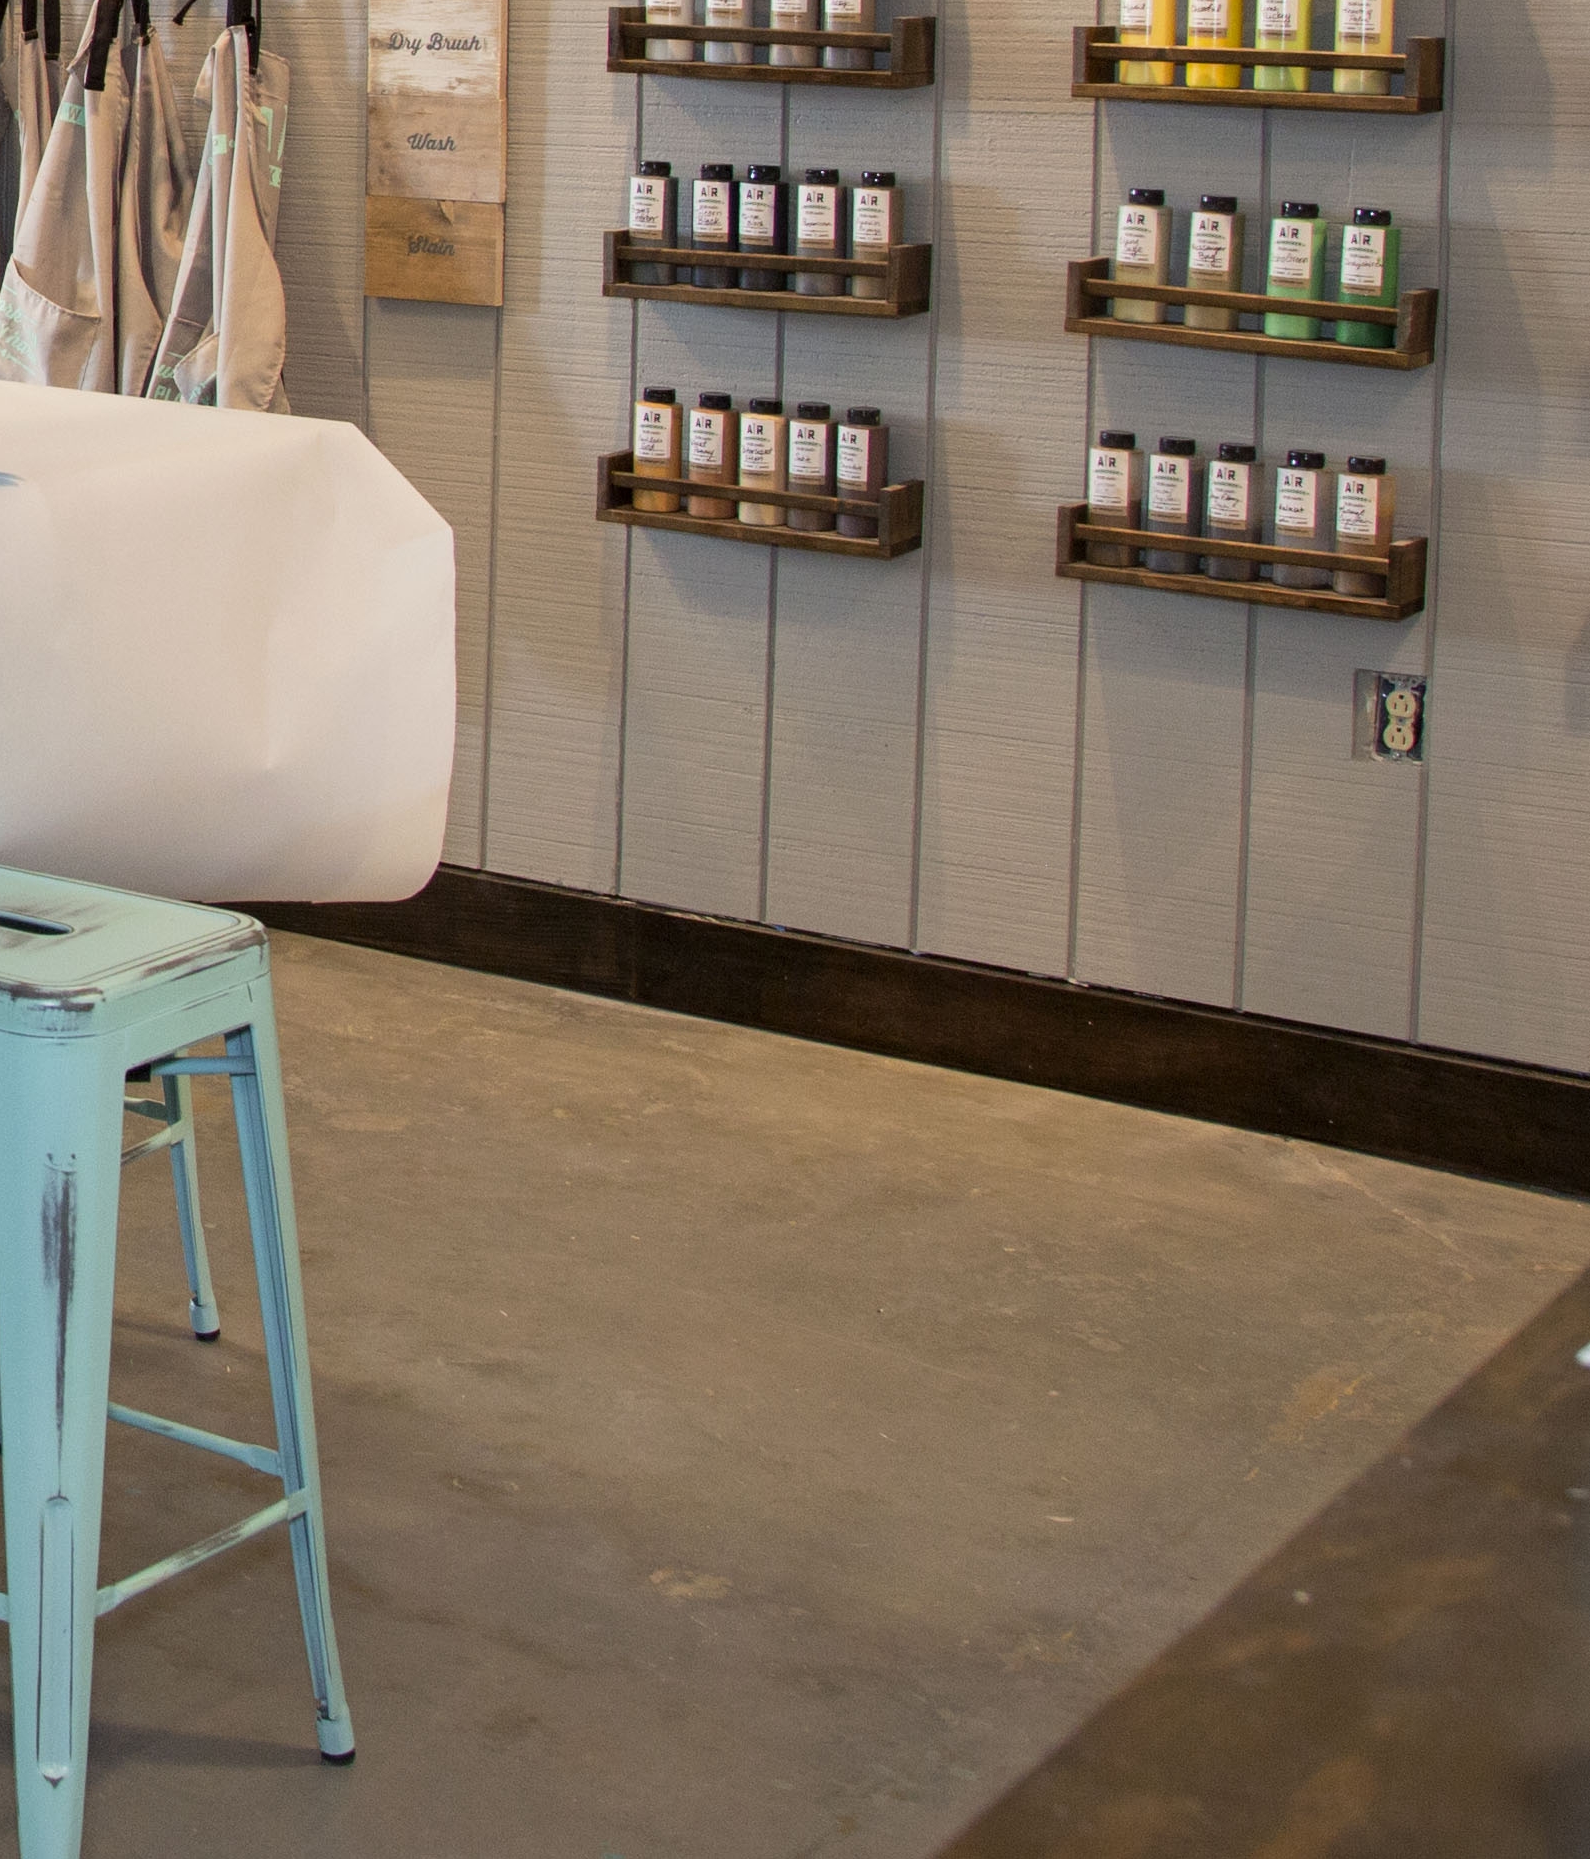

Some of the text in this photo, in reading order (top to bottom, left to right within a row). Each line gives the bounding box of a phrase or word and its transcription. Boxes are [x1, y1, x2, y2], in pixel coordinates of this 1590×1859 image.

[387, 31, 482, 52] Dry Brush
[406, 132, 457, 152] Wash
[406, 235, 456, 258] Stain
